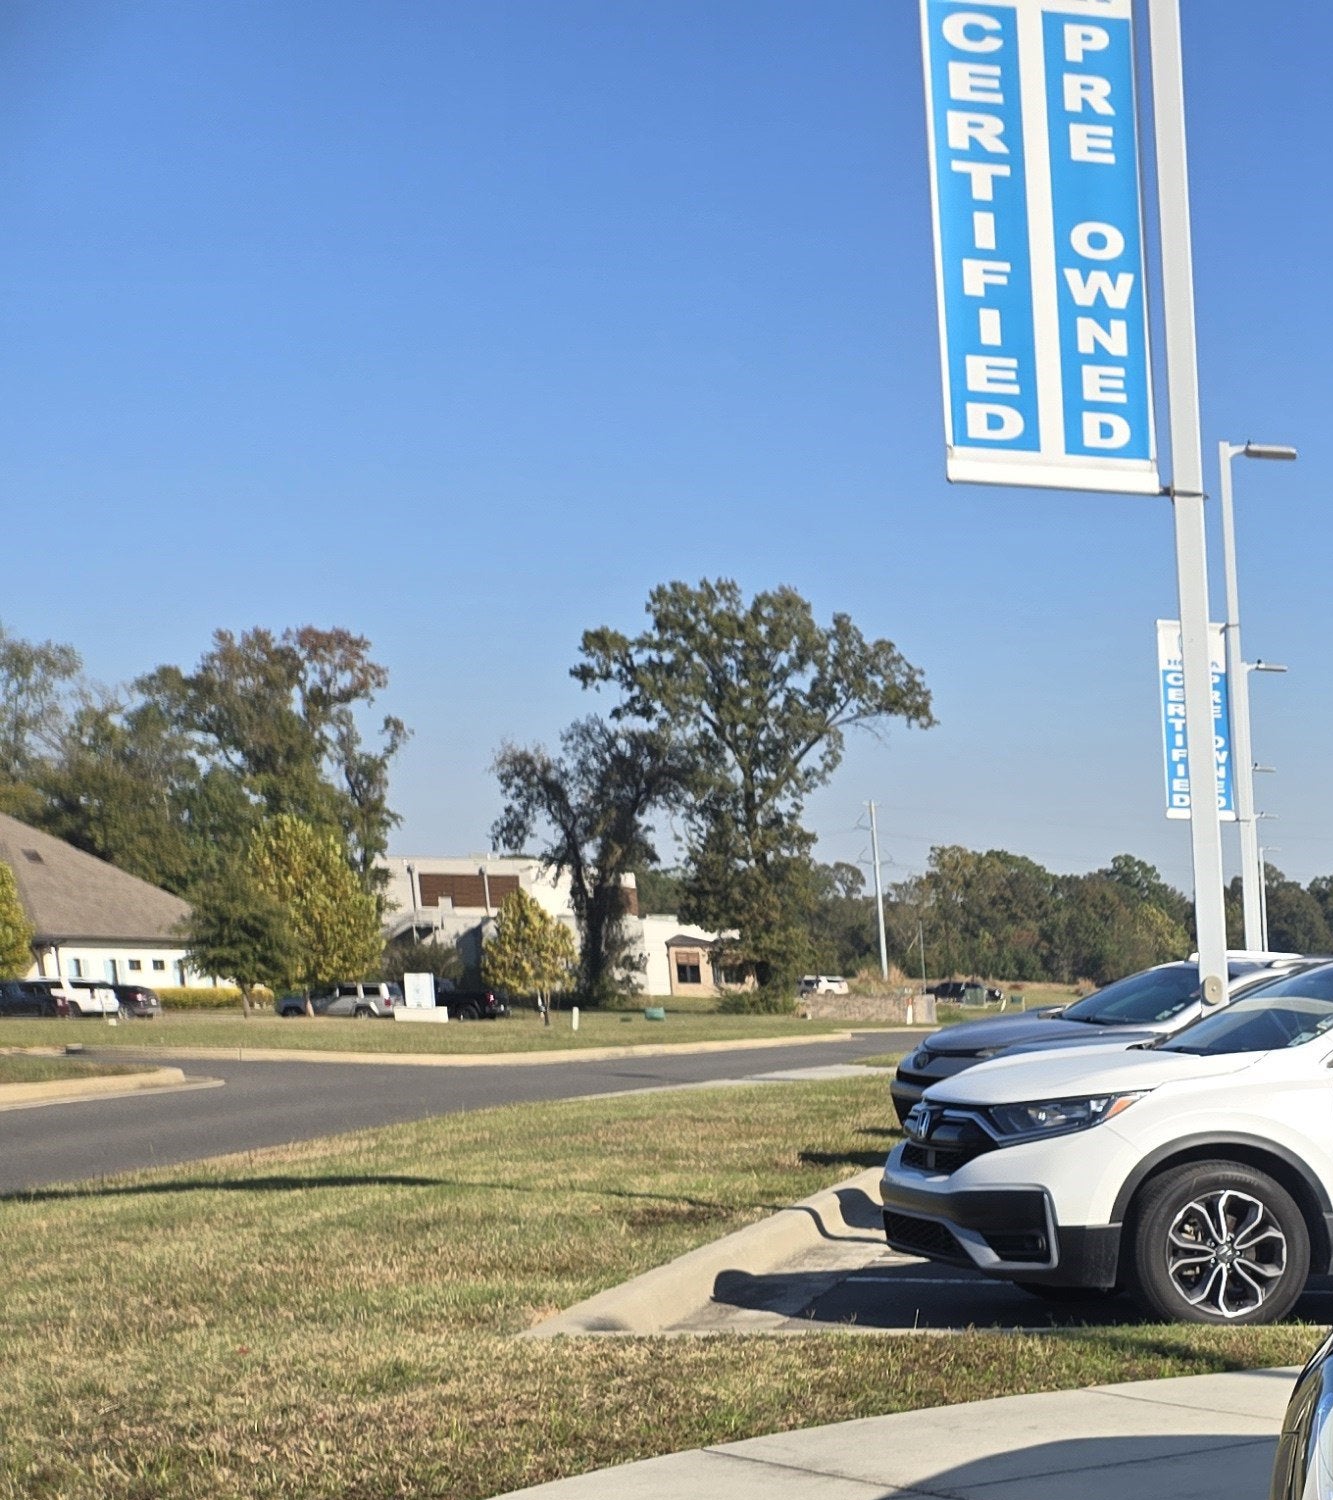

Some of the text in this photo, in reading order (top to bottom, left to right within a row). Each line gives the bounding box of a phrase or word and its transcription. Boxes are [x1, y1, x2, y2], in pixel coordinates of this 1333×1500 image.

[941, 12, 1025, 440] CERTIFIED
[1062, 23, 1135, 450] PRE OWNED
[1166, 672, 1191, 808] CERTIFIED
